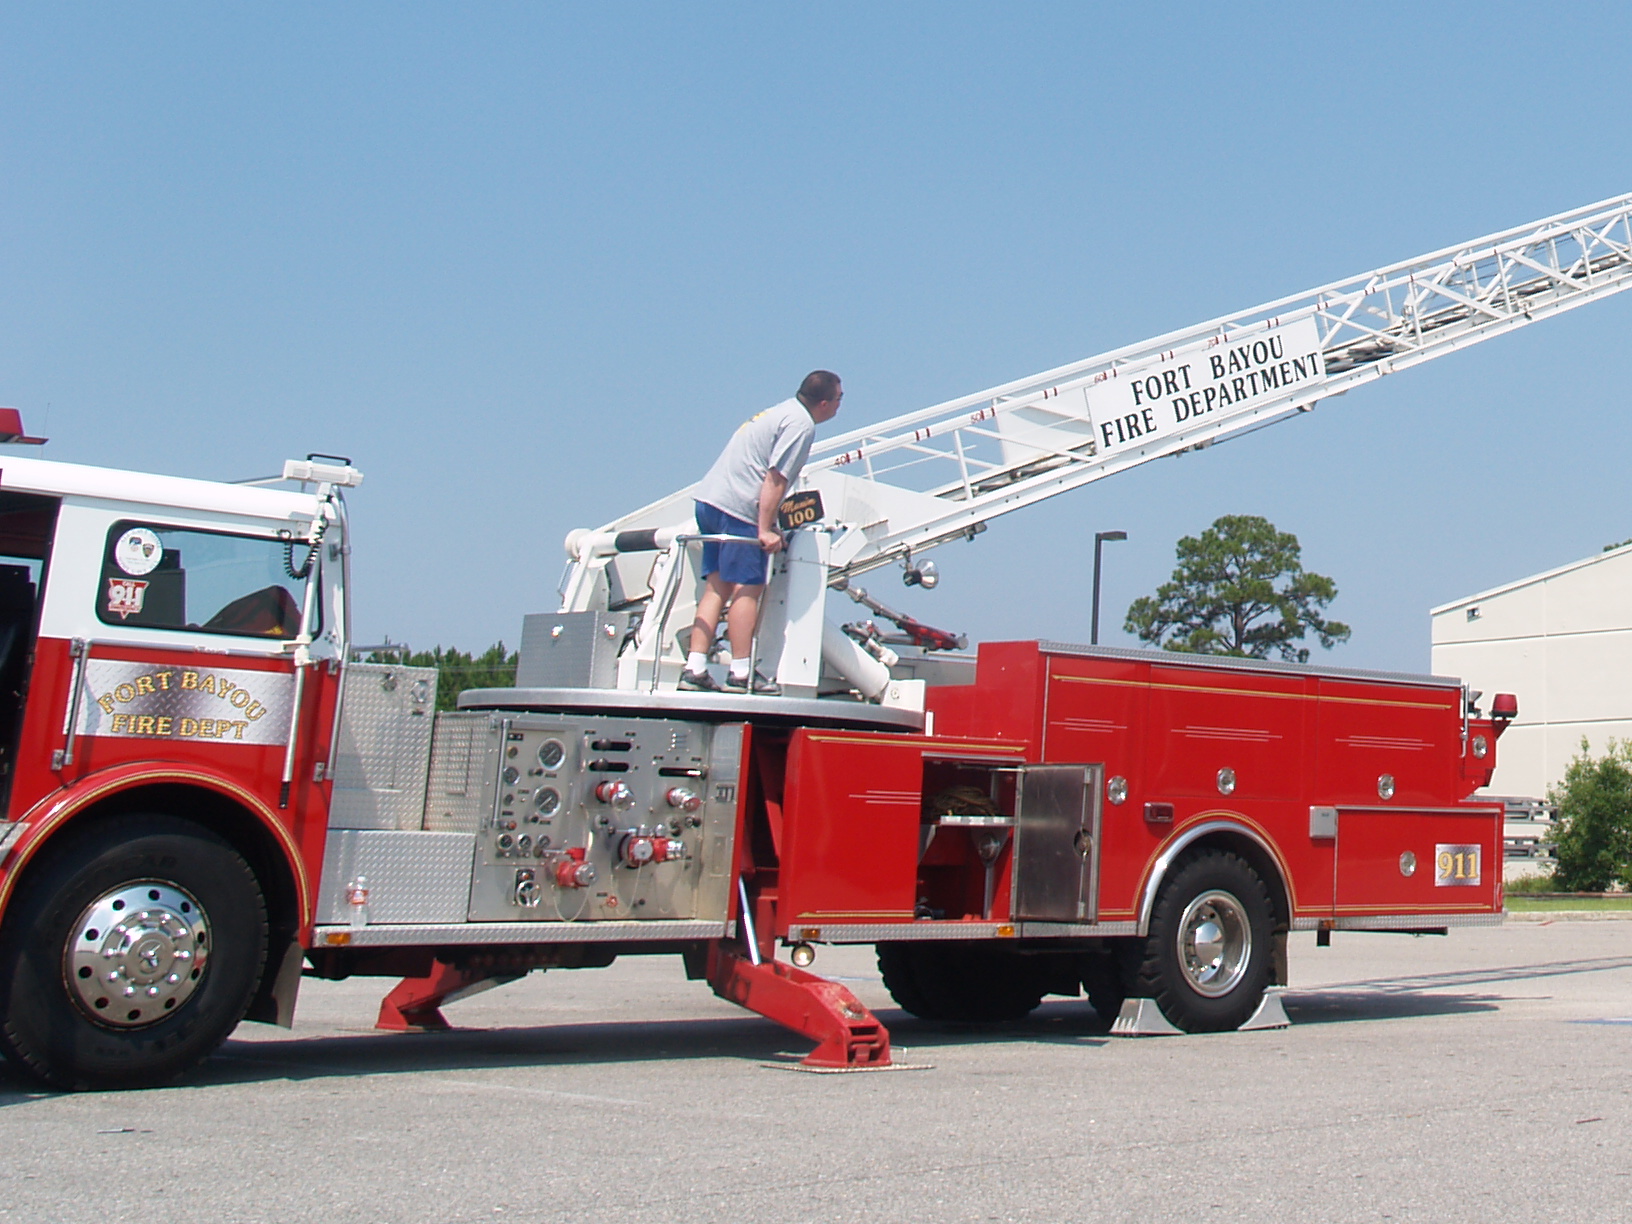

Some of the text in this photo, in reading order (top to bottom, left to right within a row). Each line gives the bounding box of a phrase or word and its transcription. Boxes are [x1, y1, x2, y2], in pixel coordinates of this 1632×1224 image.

[1130, 334, 1284, 406] FORT BAYOU
[1099, 351, 1319, 448] FIRE DEPARTMENT
[788, 507, 815, 527] 100
[97, 670, 267, 721] FORT BAYOU
[111, 713, 249, 740] FIRE DEPT
[1438, 851, 1478, 879] 911
